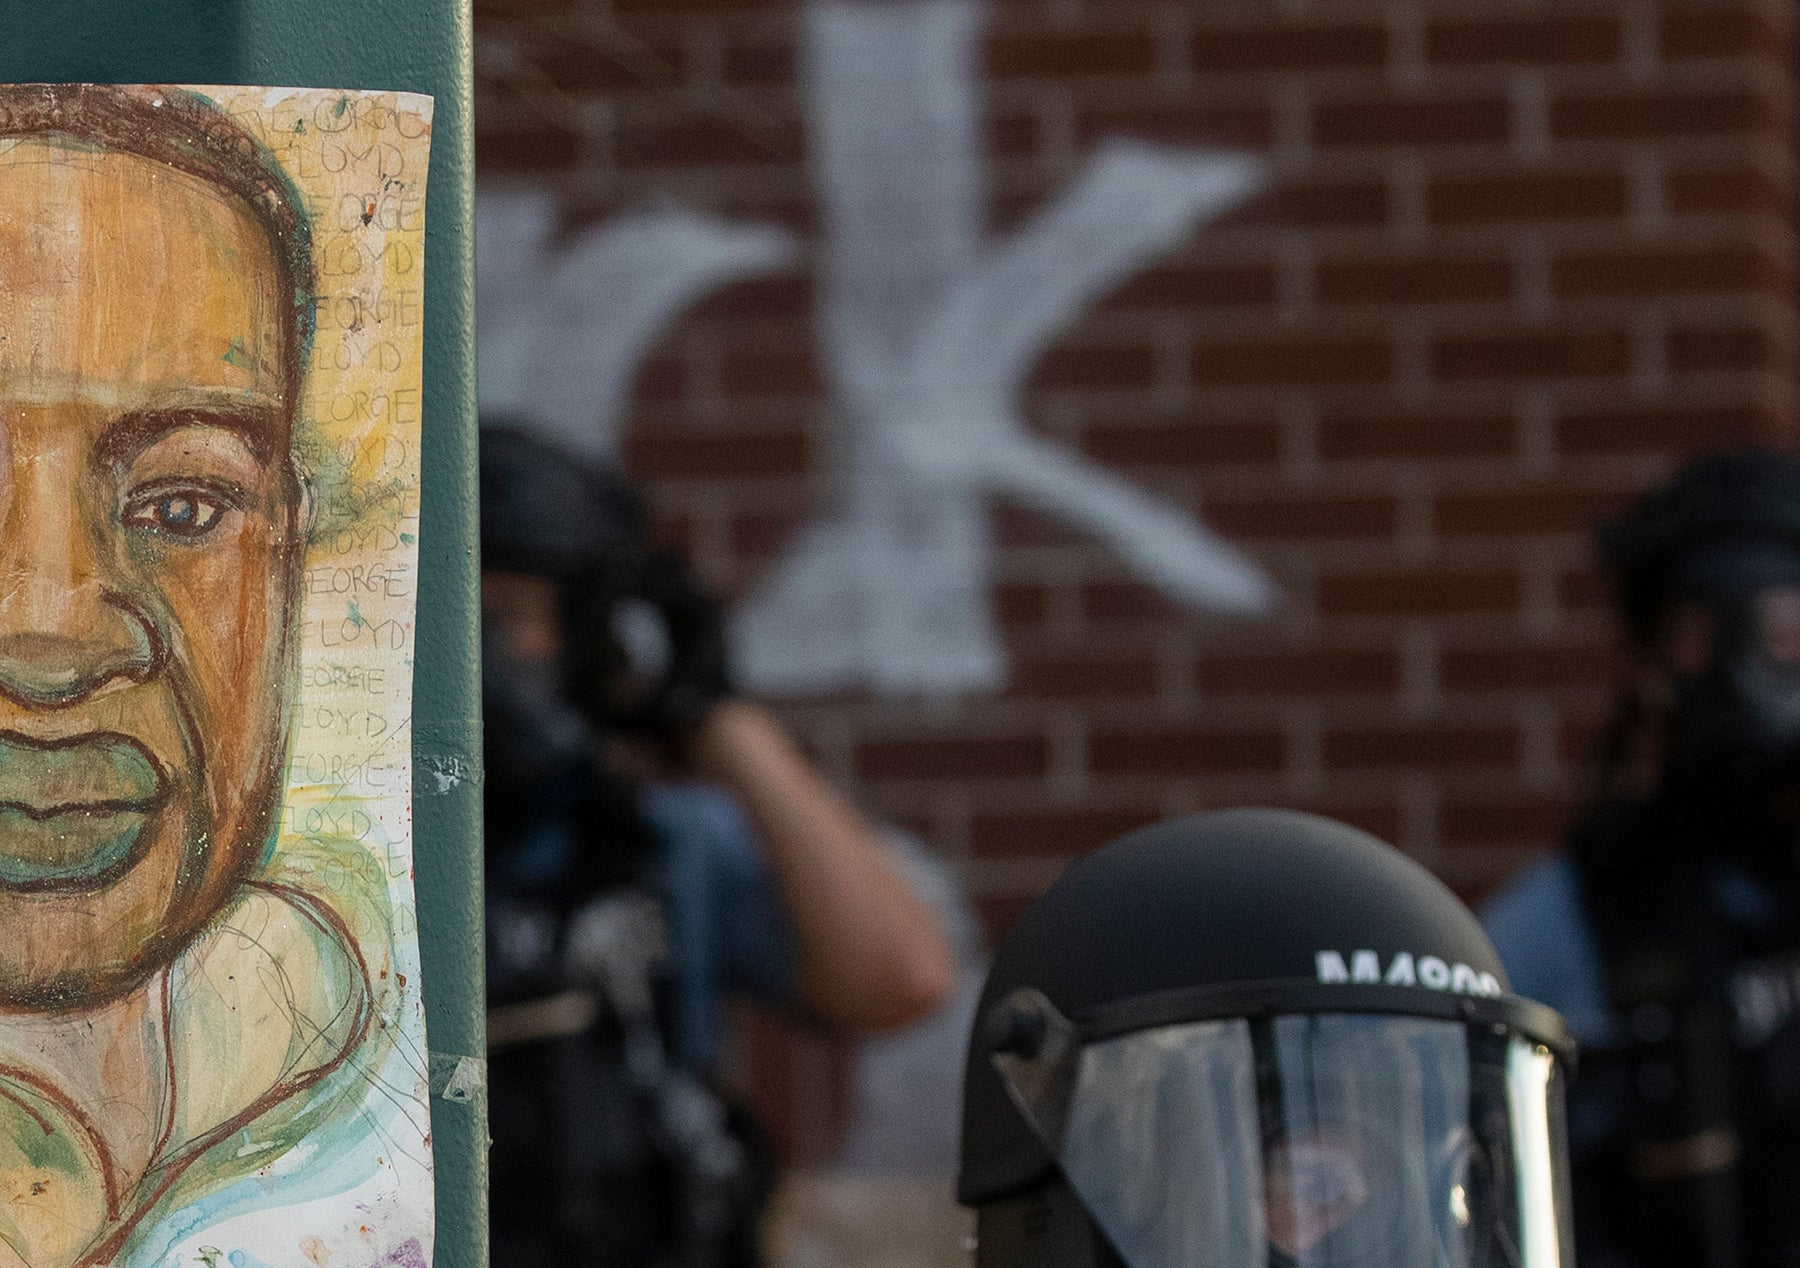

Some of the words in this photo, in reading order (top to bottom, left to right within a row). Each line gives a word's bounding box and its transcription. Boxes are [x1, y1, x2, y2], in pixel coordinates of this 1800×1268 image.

[320, 240, 413, 277] LOYD
[310, 285, 418, 333] EORGE
[311, 340, 402, 373] LOYD
[310, 386, 417, 425] EORGE
[301, 562, 410, 601] EORGE
[302, 660, 385, 695] EORGE
[288, 752, 386, 788] EORGE
